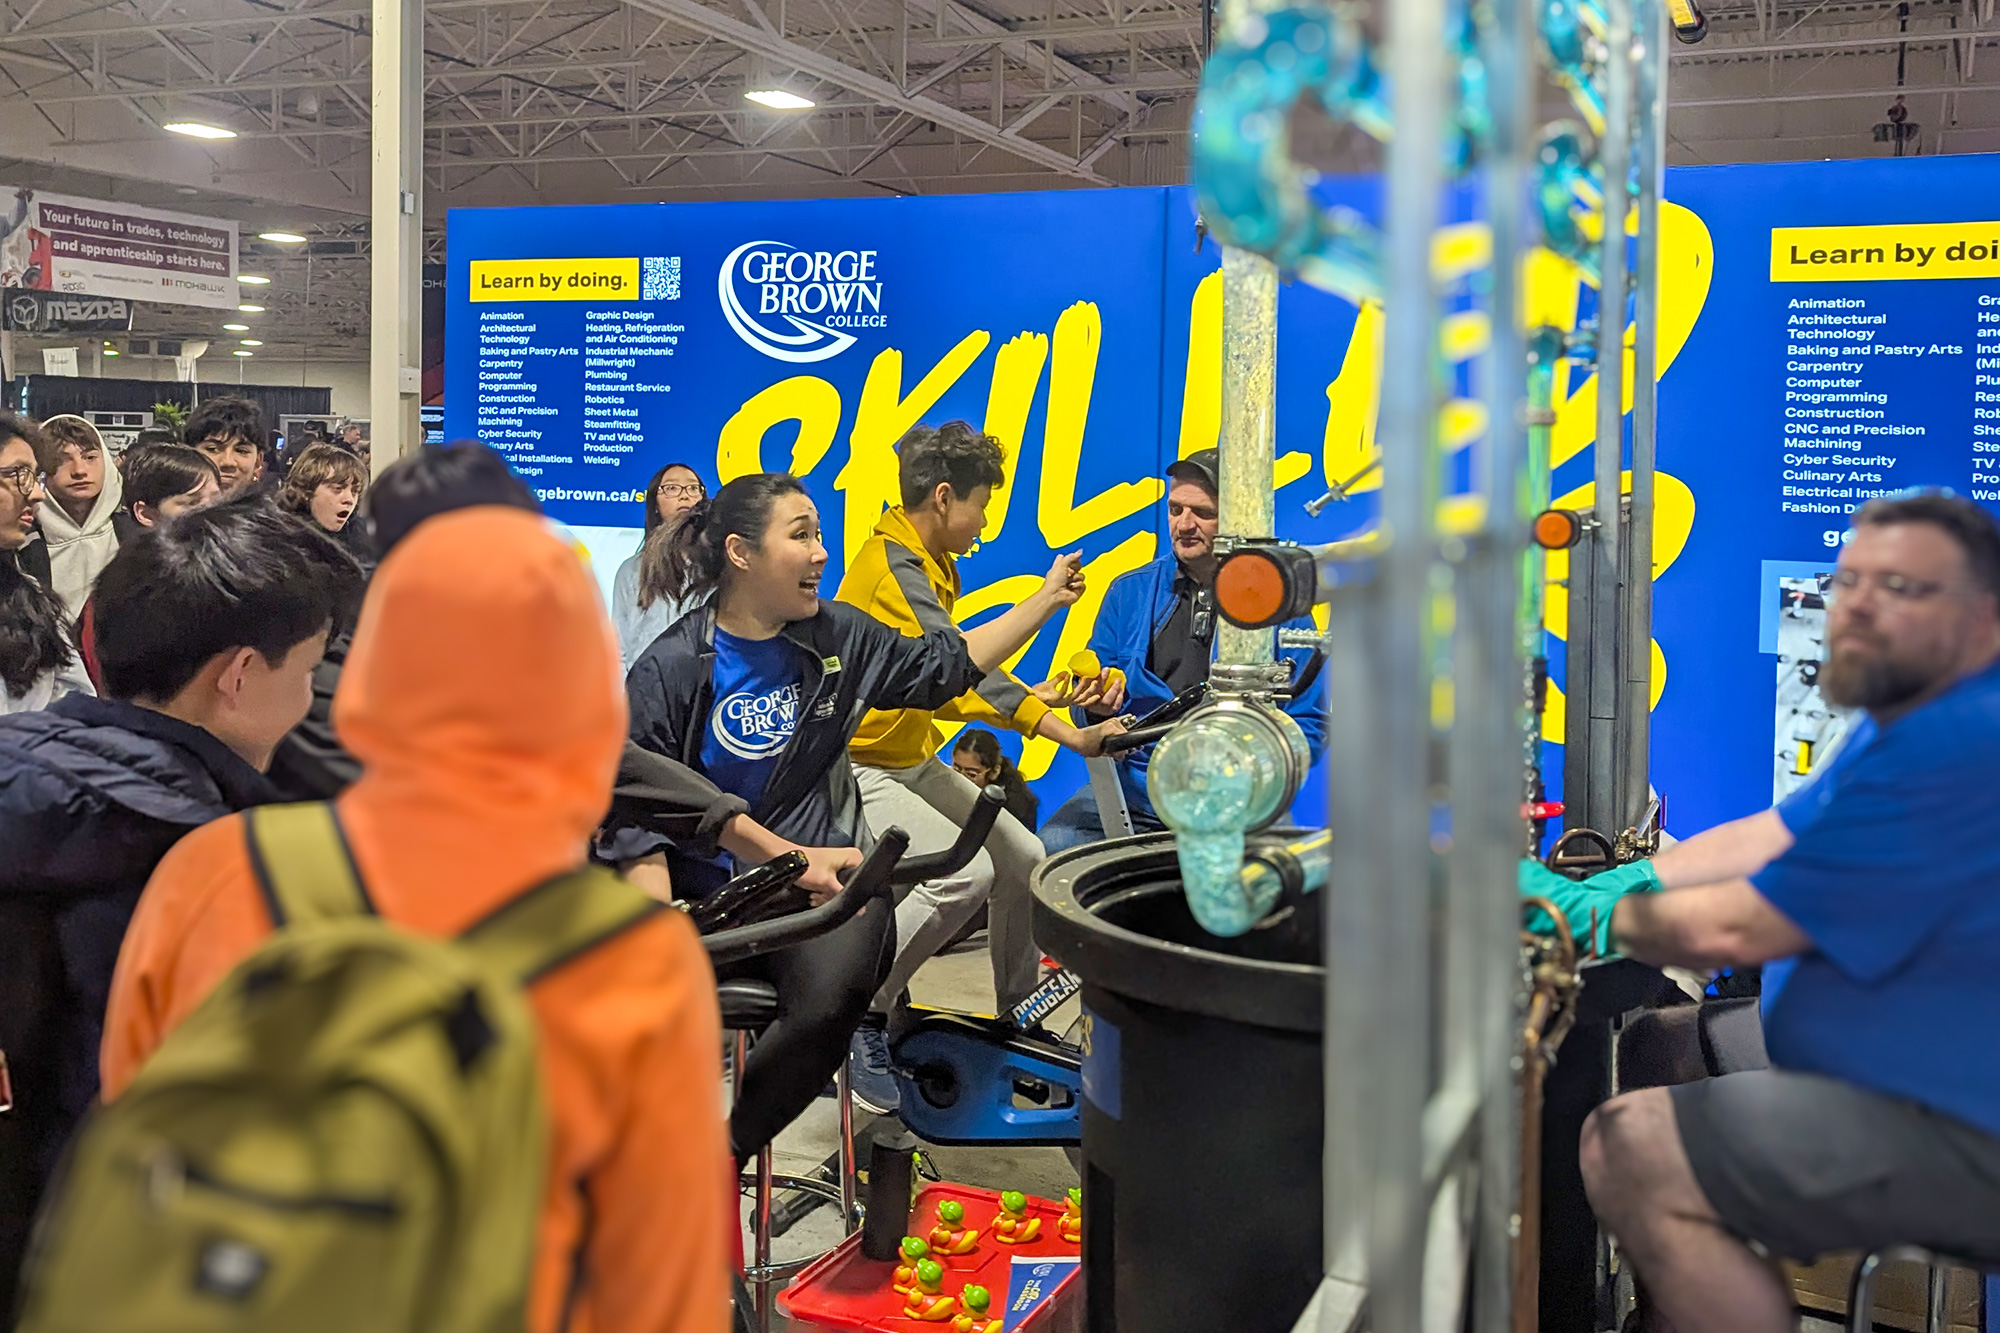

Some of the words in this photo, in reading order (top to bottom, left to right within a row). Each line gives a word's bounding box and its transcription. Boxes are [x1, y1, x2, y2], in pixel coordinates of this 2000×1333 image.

[43, 209, 72, 225] Your
[73, 213, 110, 230] future
[112, 219, 124, 233] in
[127, 222, 164, 240] trades,
[167, 228, 225, 248] technology
[53, 238, 78, 252] and
[80, 241, 164, 264] apprenticeship
[166, 252, 198, 268] starts
[200, 255, 225, 271] here.
[1790, 245, 1884, 265] Learn
[1895, 243, 1936, 267] by
[742, 250, 878, 283] GEORGE
[481, 273, 534, 289] Learn
[539, 272, 563, 291] by
[567, 272, 628, 291] doing.
[759, 282, 883, 314] BROWN
[1788, 298, 1865, 308] Animation
[46, 300, 128, 321] mazda
[480, 312, 524, 320] Animation
[586, 311, 620, 321] Graphic
[623, 311, 654, 321] Design
[1788, 314, 1886, 324] Architectural
[825, 315, 888, 328] COLLEGE
[480, 324, 536, 332] Architectural
[586, 324, 623, 333] Heating,
[625, 324, 684, 333] Refrigeration
[480, 335, 530, 344] Technology
[1787, 329, 1875, 340] Technology
[586, 335, 602, 343] and
[604, 335, 617, 343] Air
[618, 335, 677, 345] Conditioning
[480, 347, 509, 357] Baking
[511, 347, 527, 355] and
[529, 347, 557, 357] Pastry
[559, 347, 578, 355] Arts
[586, 347, 628, 355] Industrial
[630, 347, 673, 355] Mechanic
[1788, 345, 1838, 357] Baking
[1842, 345, 1870, 355] and
[1875, 345, 1925, 357] Pastry
[1928, 344, 1962, 354] Arts
[480, 360, 523, 369] Carpentry
[586, 358, 635, 368] (Millwright)
[1787, 361, 1863, 373] Carpentry
[479, 372, 522, 381] Computer
[585, 371, 627, 380] Plumbing
[479, 382, 537, 392] Programming
[585, 383, 634, 391] Restaurant
[636, 383, 670, 392] Service
[1786, 377, 1862, 389] Computer
[585, 395, 624, 404] Robotics
[1786, 392, 1887, 404] Programming
[518, 407, 558, 415] Precision
[585, 408, 611, 416] Sheet
[613, 408, 638, 416] Metal
[1785, 407, 1884, 418] Construction
[478, 417, 522, 427] Machining
[584, 420, 640, 431] Steamfitting
[1785, 423, 1818, 434] CNC
[1822, 424, 1850, 434] and
[1854, 425, 1925, 435] Precision
[478, 430, 504, 439] Cyber
[506, 430, 542, 439] Security
[584, 432, 597, 440] TV
[598, 433, 615, 441] and
[617, 433, 643, 442] Video
[479, 442, 513, 451] linary
[515, 442, 534, 450] Arts
[584, 443, 633, 452] Production
[1785, 438, 1861, 451] Machining
[519, 454, 572, 463] Installations
[584, 456, 620, 466] Welding
[1784, 454, 1829, 466] Cyber
[1832, 455, 1896, 468] Security
[1972, 459, 1995, 468] TV
[1783, 470, 1845, 483] Culinary
[1848, 472, 1882, 482] Arts
[1783, 486, 1852, 498] Electrical
[1782, 502, 1840, 513] Fashion
